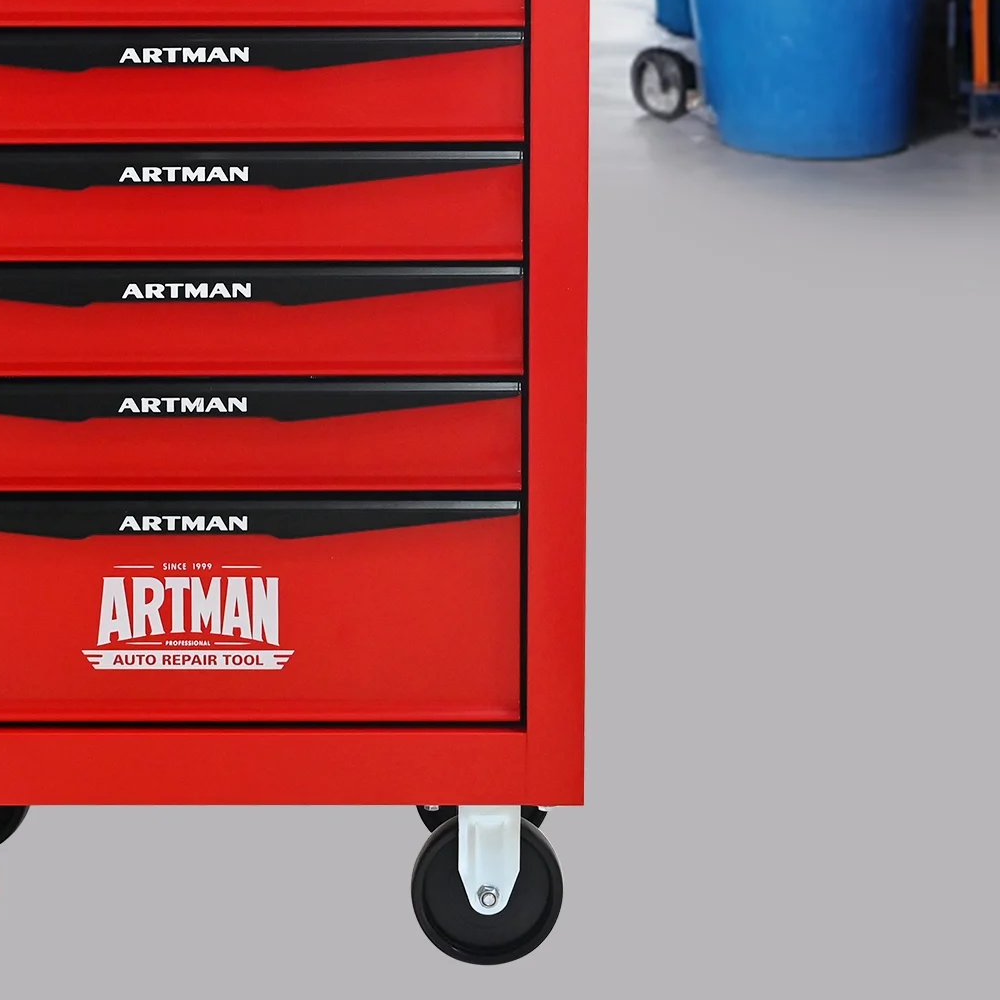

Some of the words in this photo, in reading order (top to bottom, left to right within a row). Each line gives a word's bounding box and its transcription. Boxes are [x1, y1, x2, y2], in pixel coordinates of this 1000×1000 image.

[118, 47, 250, 64] ARTMAN
[118, 166, 249, 183] ARTMAN
[121, 283, 252, 299] ARTMAN
[117, 397, 248, 413] ARTMAN
[118, 515, 248, 532] ARTMAN
[162, 562, 187, 571] SINCE
[192, 562, 213, 571] 1999
[97, 576, 280, 647] ARTMAN
[113, 654, 157, 666] AUTO
[162, 654, 218, 666] REPAIR
[222, 654, 264, 666] TOOL
